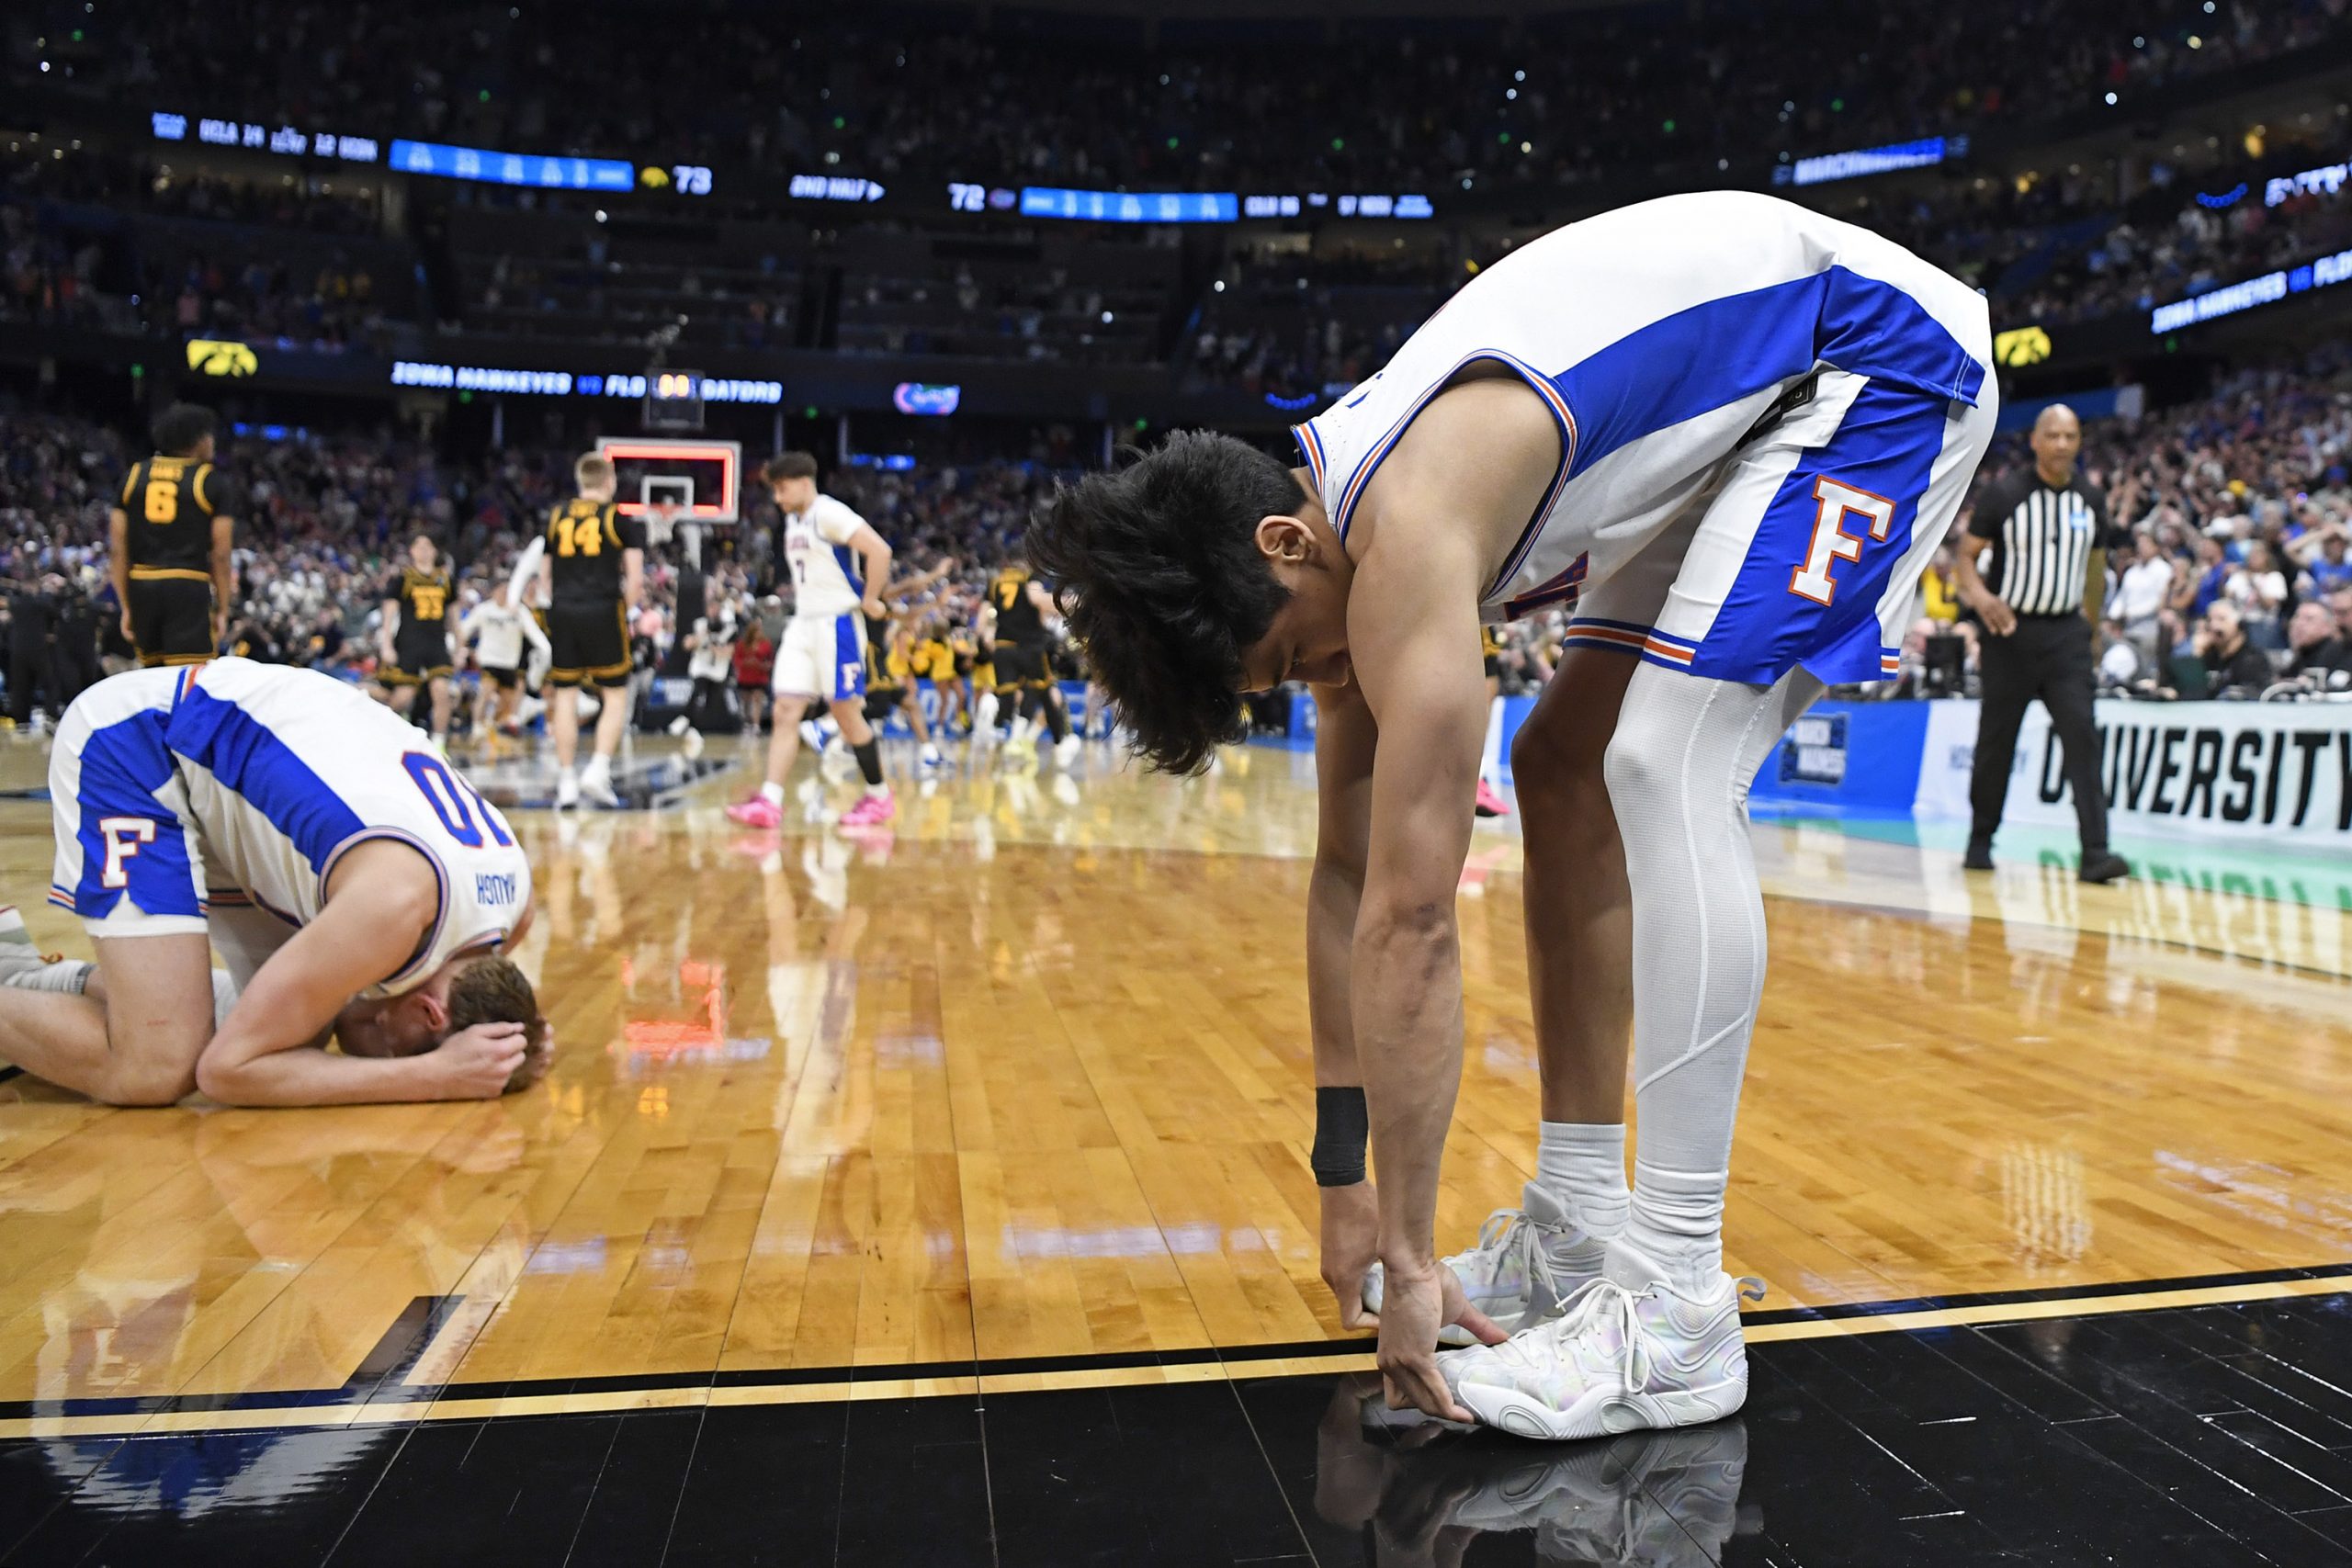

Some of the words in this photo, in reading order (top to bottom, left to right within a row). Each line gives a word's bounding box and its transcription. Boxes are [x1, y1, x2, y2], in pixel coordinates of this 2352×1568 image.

[673, 165, 711, 195] 73
[947, 183, 985, 211] 72
[390, 361, 454, 388] IOWA
[456, 367, 572, 395] HAWKEYES
[700, 378, 783, 404] GATORS
[145, 480, 178, 524] 6
[558, 516, 603, 557] 14
[1787, 473, 1897, 607] F
[840, 662, 862, 691] F
[2038, 724, 2352, 830] UIVERSITY
[98, 816, 157, 889] F
